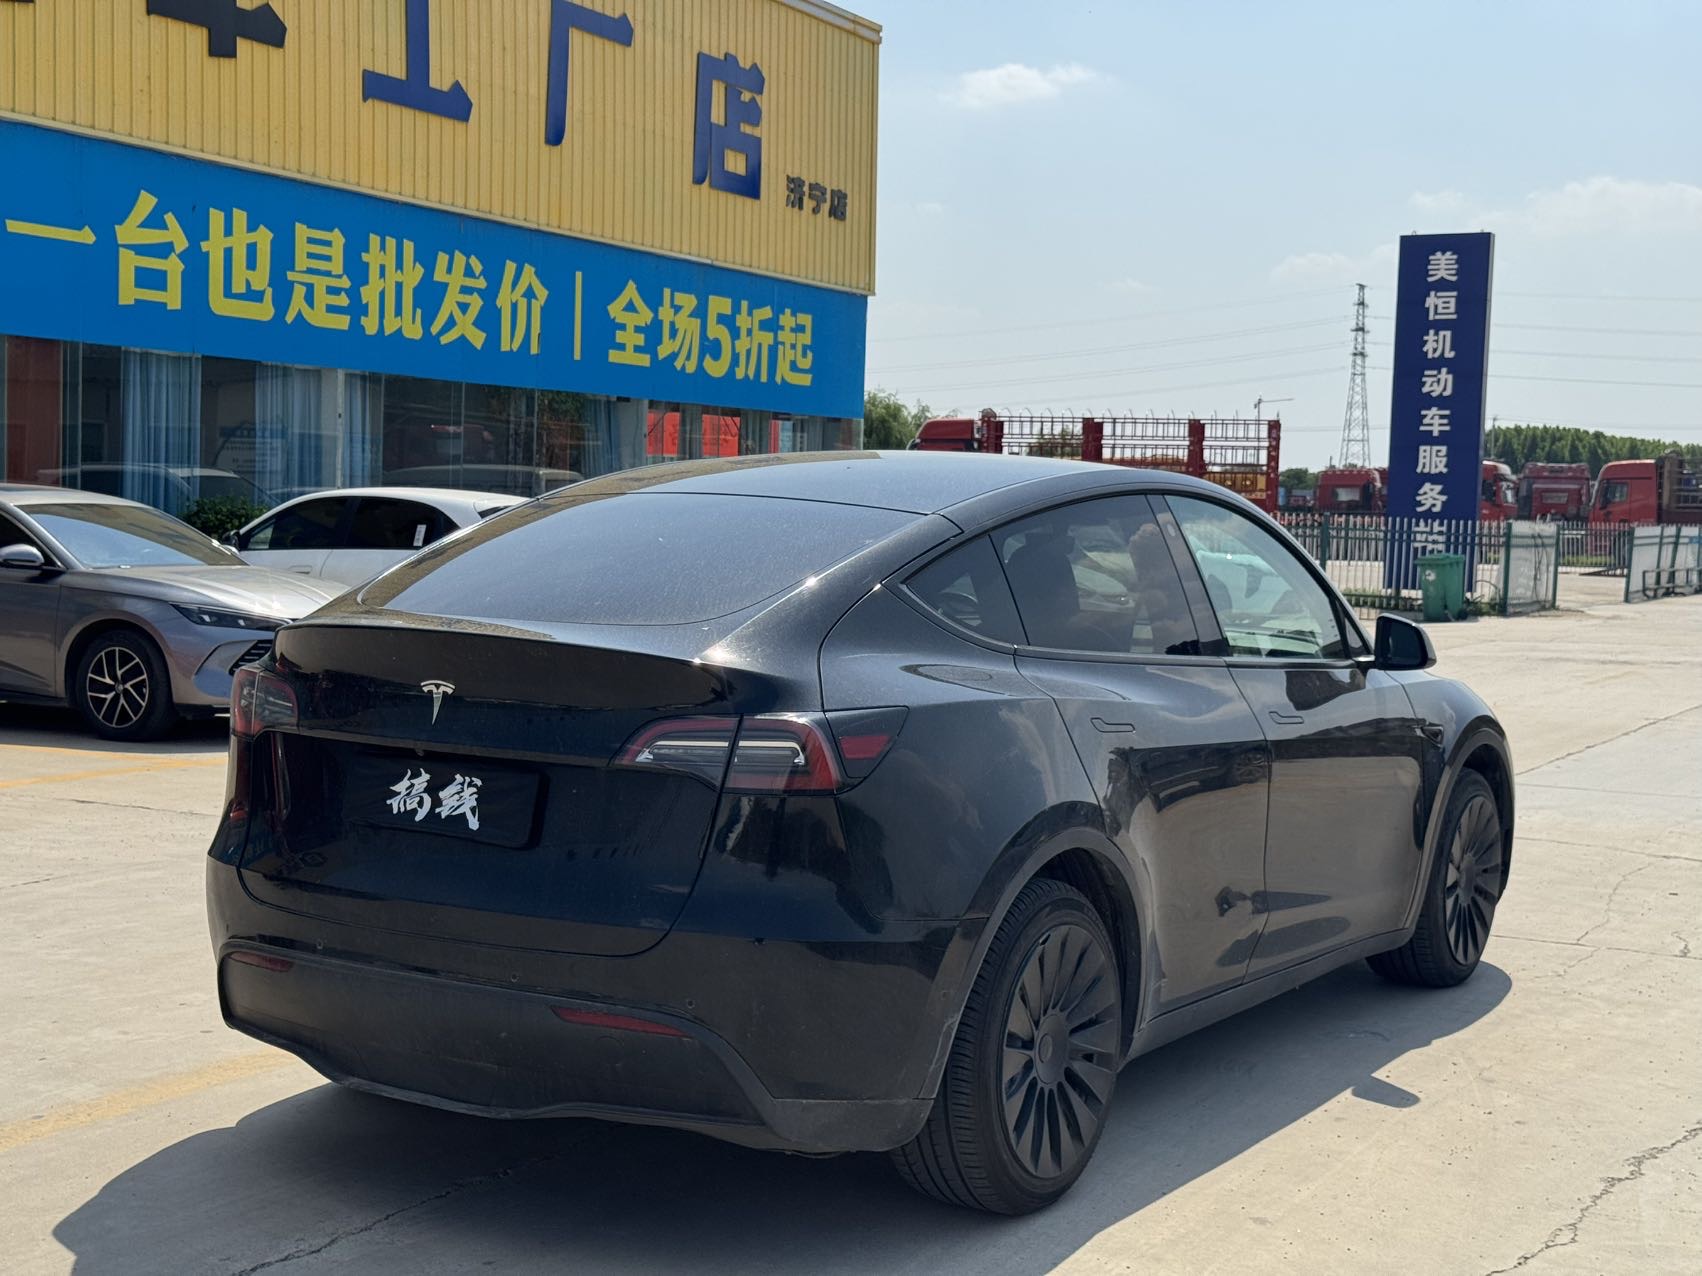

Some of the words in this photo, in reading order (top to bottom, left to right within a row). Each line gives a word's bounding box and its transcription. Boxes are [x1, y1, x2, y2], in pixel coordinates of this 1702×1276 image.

[786, 174, 848, 221] 济宁店
[5, 188, 549, 355] 一台也是批发价
[607, 279, 813, 386] 全场5折起
[386, 768, 482, 831] 搞钱
